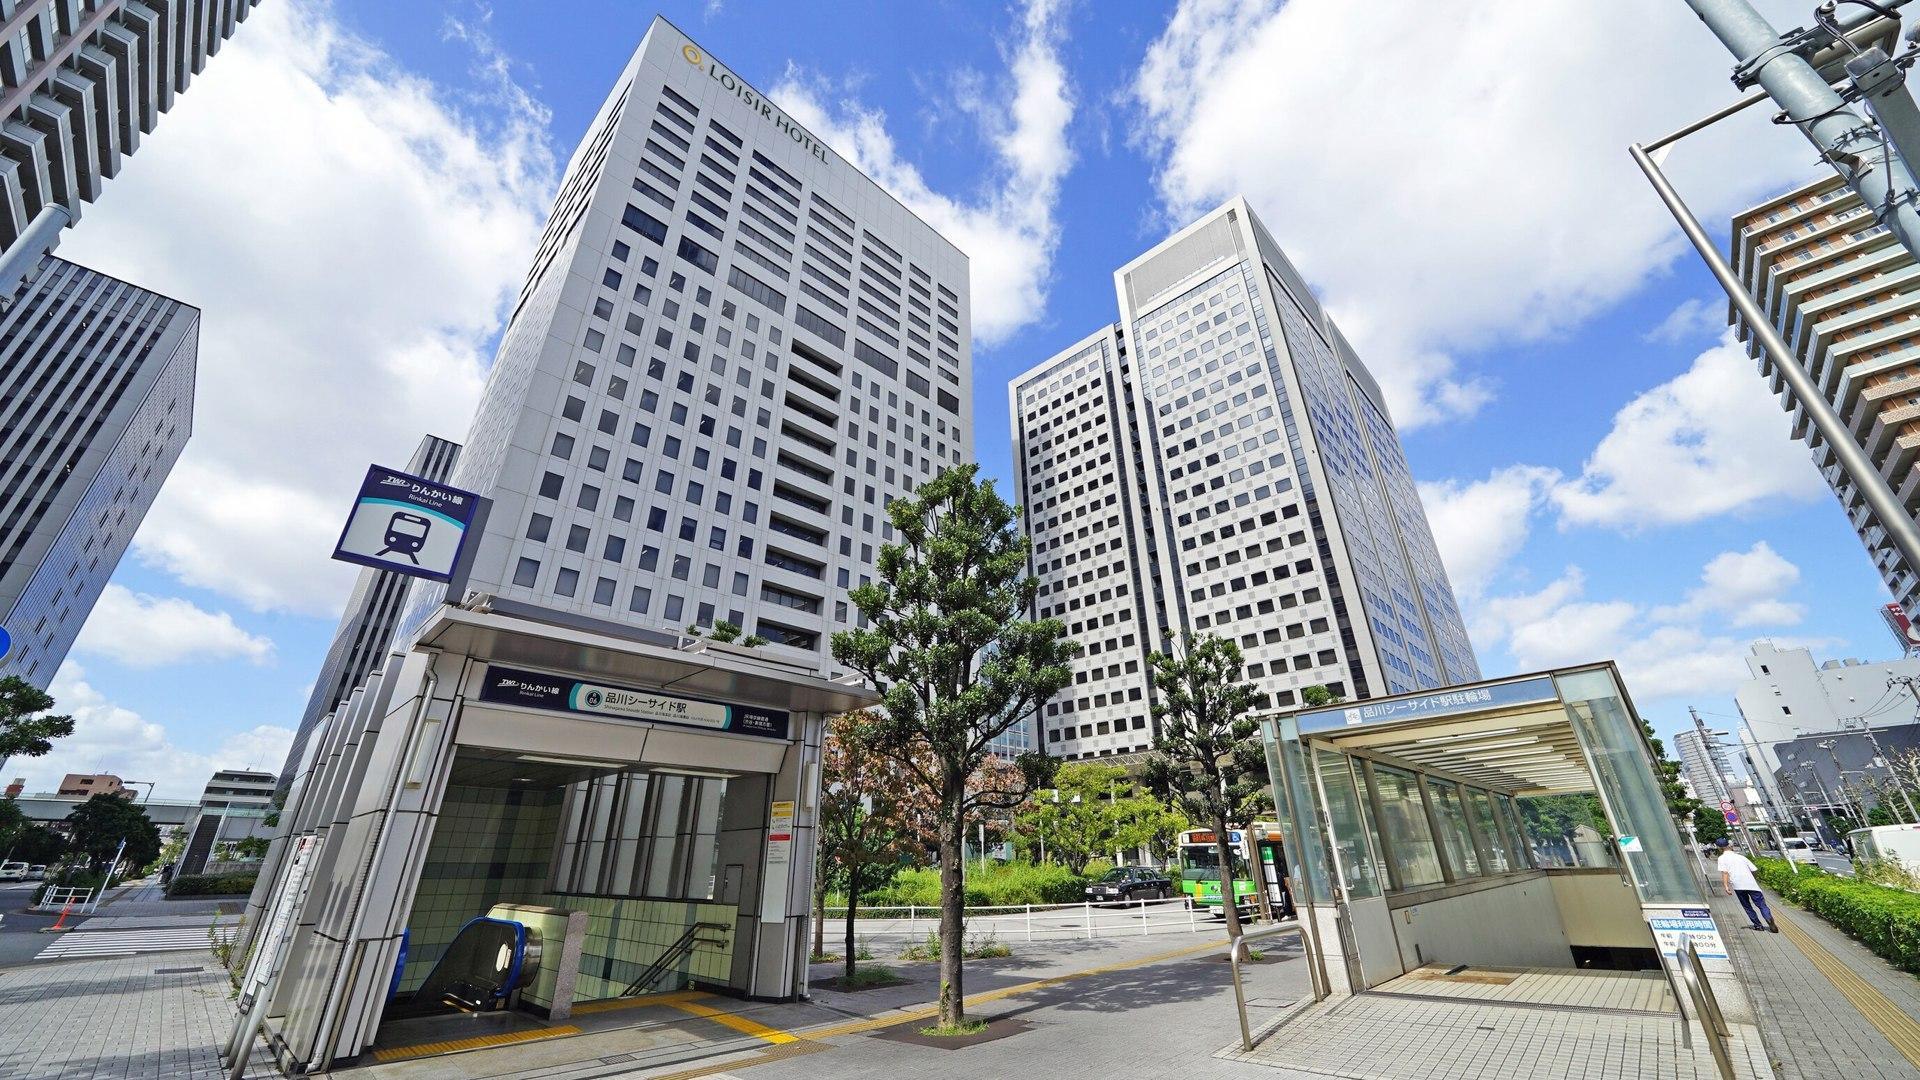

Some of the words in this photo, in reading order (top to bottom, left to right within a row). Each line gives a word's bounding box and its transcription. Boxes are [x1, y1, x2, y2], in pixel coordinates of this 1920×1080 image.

[709, 64, 772, 121] LOISIR
[776, 115, 829, 166] HOTEL
[408, 493, 428, 504] Rinkai
[428, 499, 443, 507] Line
[411, 483, 464, 505] りんかい線
[520, 682, 560, 695] りんかい線
[605, 691, 687, 713] 品川シーサイド駅
[1363, 689, 1492, 718] 品川シーサイド駅駐輪場
